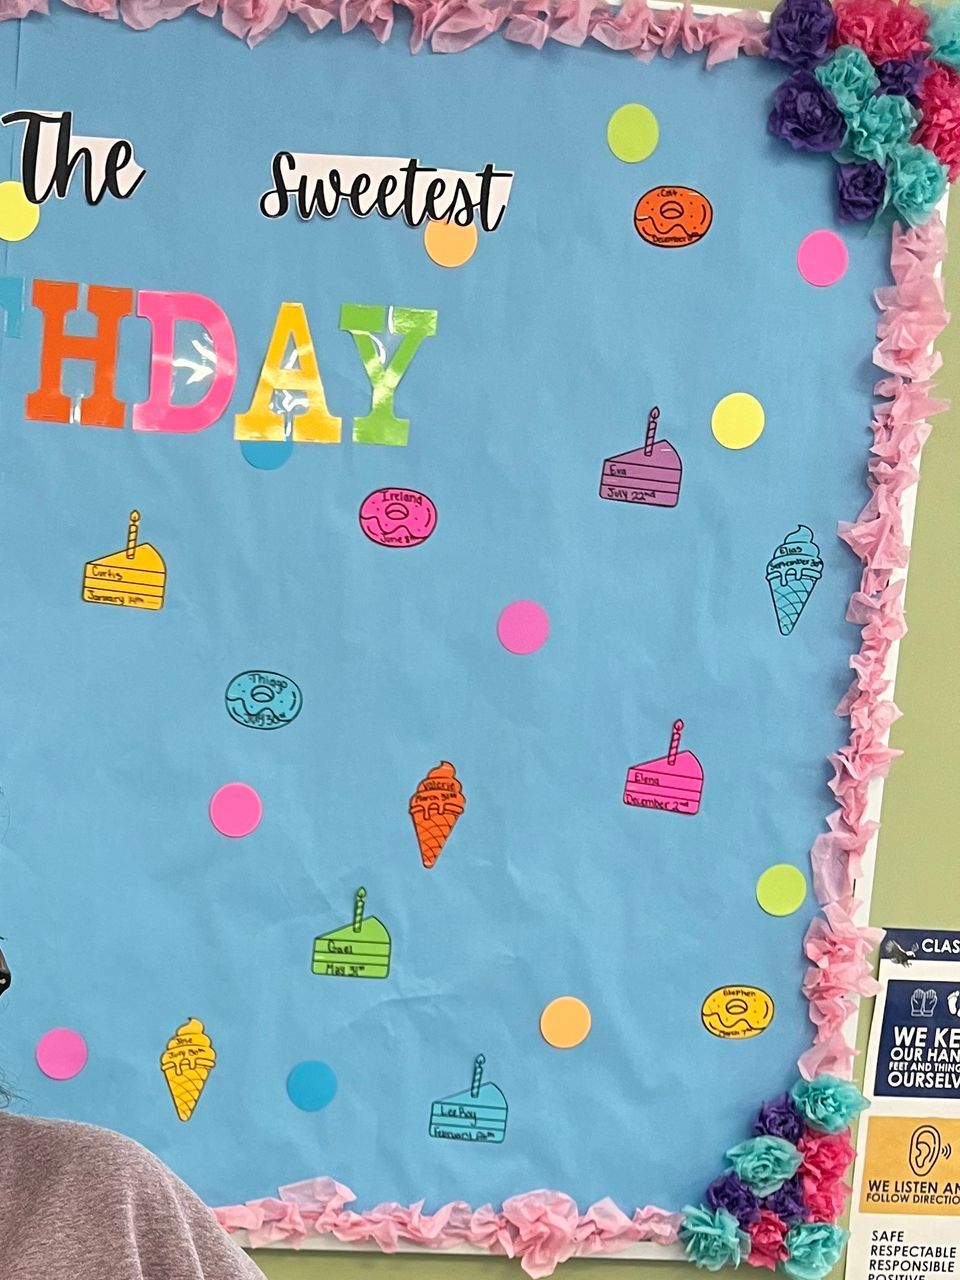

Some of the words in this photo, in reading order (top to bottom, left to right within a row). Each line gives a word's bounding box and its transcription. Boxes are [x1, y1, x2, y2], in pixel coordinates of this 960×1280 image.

[1, 111, 146, 206] The
[260, 152, 513, 231] Sweetest
[609, 465, 626, 476] Eva
[607, 487, 627, 501] July
[91, 567, 122, 581] Curtis
[634, 772, 659, 787] Elena
[894, 1026, 928, 1048] WE
[890, 1047, 923, 1063] OUR
[889, 1062, 909, 1072] FEET
[910, 1063, 933, 1073] AND
[868, 1180, 890, 1193] WE
[894, 1180, 938, 1195] LISTEN
[866, 1192, 910, 1203] FOLLOW
[871, 1230, 905, 1243] SAFE
[870, 1245, 957, 1258] RESPECTABLE
[869, 1260, 955, 1273] RESPONSIBLE
